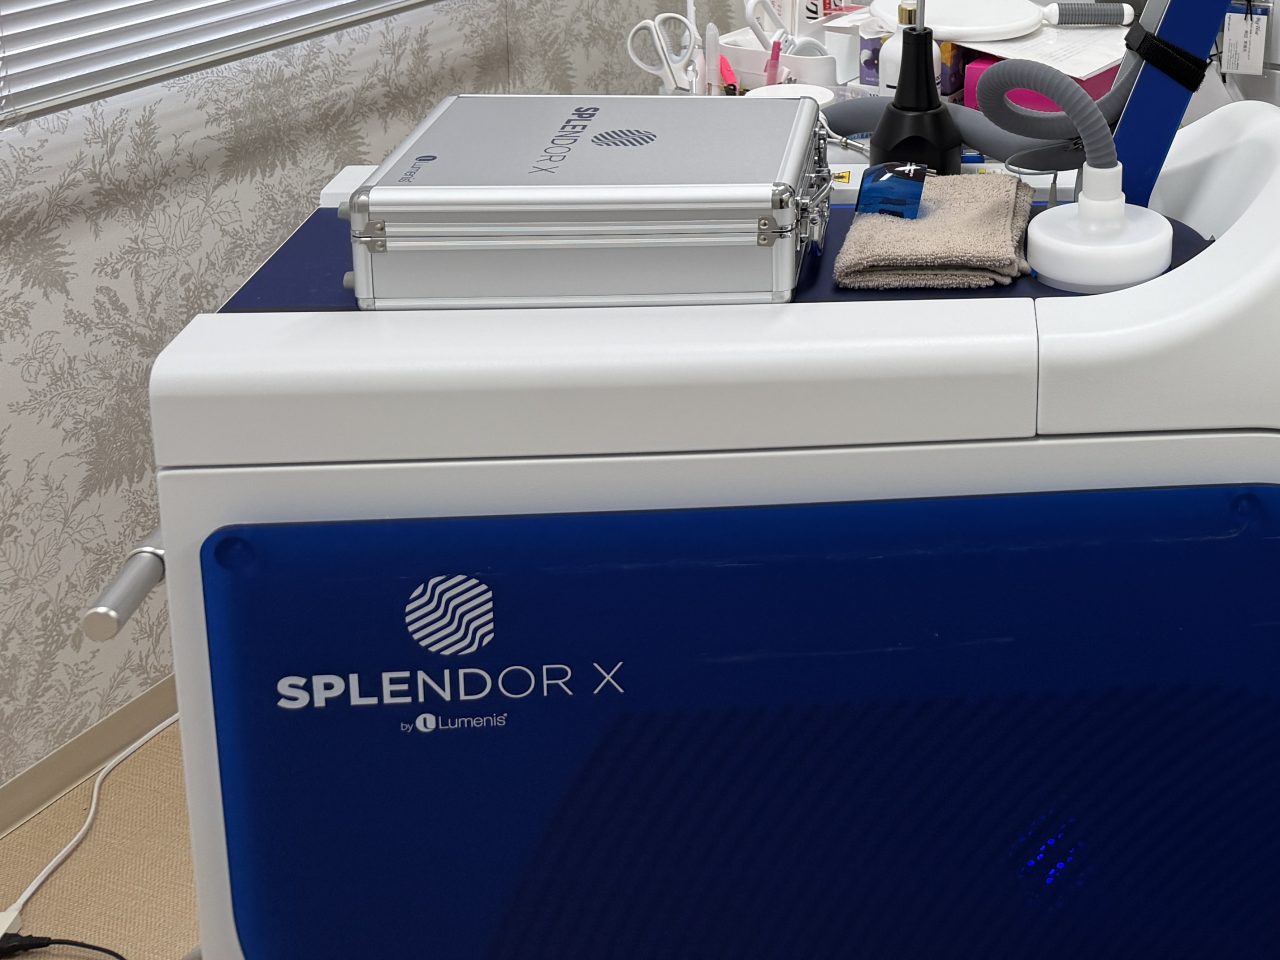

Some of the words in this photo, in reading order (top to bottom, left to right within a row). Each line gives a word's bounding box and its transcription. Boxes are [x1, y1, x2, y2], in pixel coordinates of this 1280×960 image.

[535, 106, 600, 163] SPLENDOR
[528, 165, 560, 175] X
[276, 664, 574, 709] SPLENDOR
[592, 661, 625, 694] X
[400, 722, 414, 733] by
[438, 713, 506, 729] Lumenis
